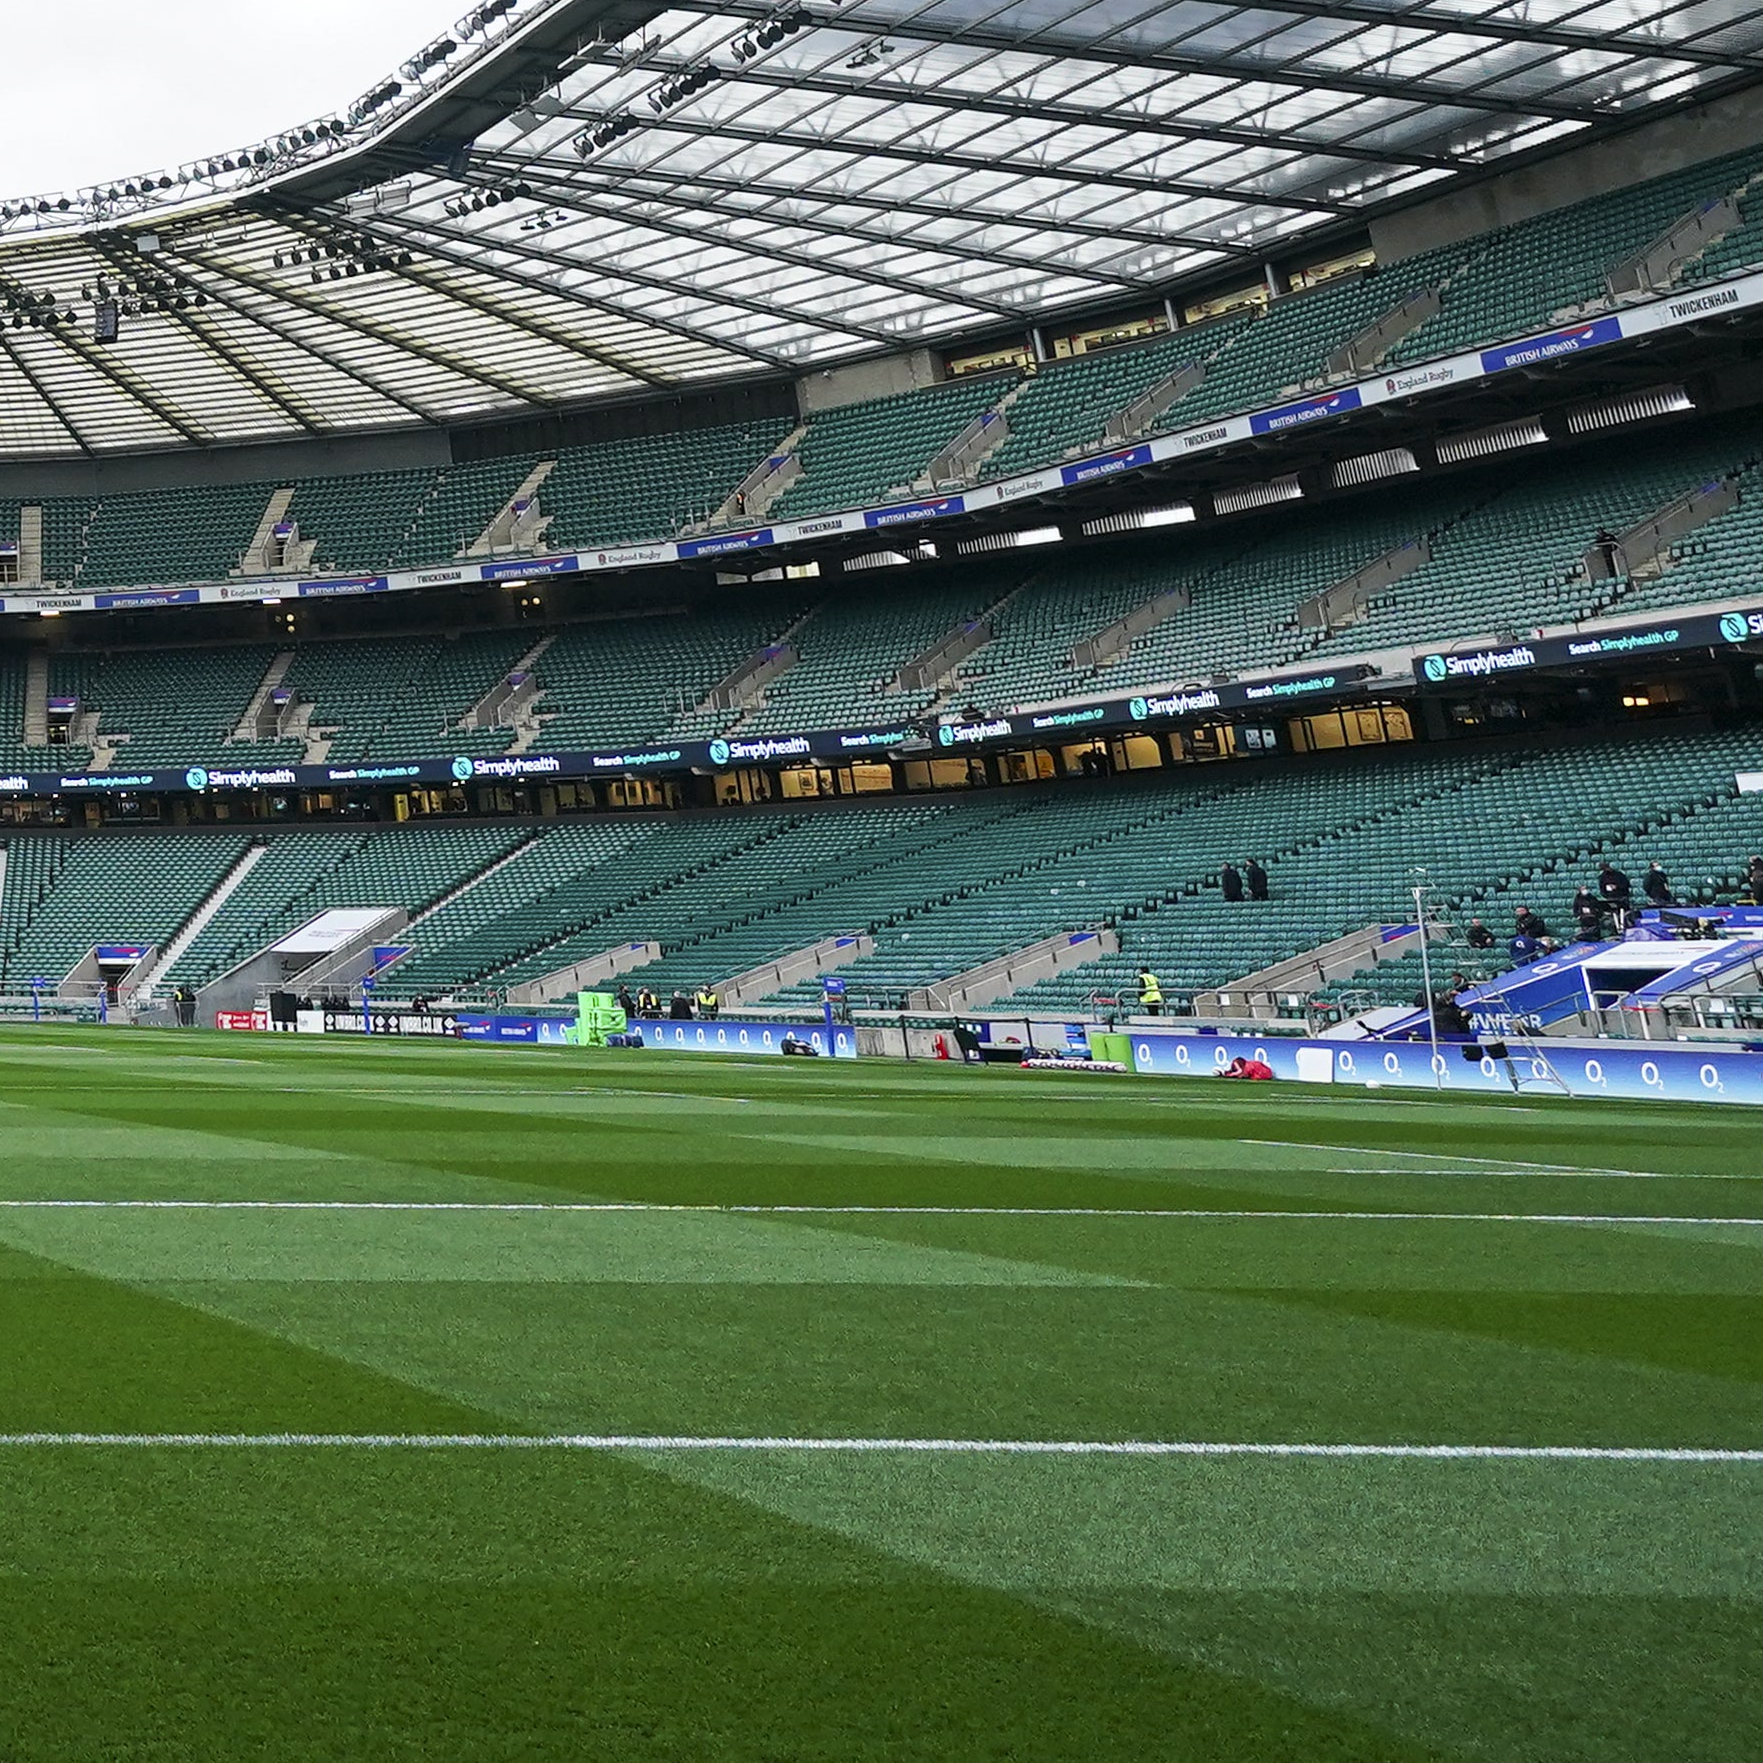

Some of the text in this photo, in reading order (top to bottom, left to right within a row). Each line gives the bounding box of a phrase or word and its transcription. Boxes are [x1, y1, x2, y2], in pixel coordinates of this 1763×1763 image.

[1669, 290, 1739, 318] TWICKENHAM
[1505, 340, 1579, 367] BRITISH AIRWAYS
[1397, 368, 1454, 391] England Rugby
[1269, 407, 1327, 429] BRITISH AIRWAYS
[1184, 427, 1227, 448] TWICKENHAM
[797, 520, 842, 534] TWICKENHAM
[878, 508, 935, 525] BRITISH AIRWAYS
[608, 550, 661, 564] England Rugby
[697, 539, 749, 554] BRITISH AIRWAYS
[417, 571, 462, 583] TWICKENHAM
[230, 587, 281, 598] England Rugby
[1569, 630, 1679, 655] Search Simplyhealth GP
[1446, 648, 1535, 675] Simplyhealth
[1246, 677, 1335, 698] Search Simplyhealth GP
[1147, 692, 1219, 715] Simplyhealth
[841, 735, 869, 746] Search
[953, 720, 1012, 742] Simplyhealth
[730, 737, 811, 759] Simplyhealth
[473, 757, 559, 776] Simplyhealth
[209, 770, 295, 788] Simplyhealth
[1138, 1044, 1153, 1067] O2
[1175, 1044, 1191, 1068] O2
[1339, 1050, 1357, 1076] O2
[1384, 1052, 1403, 1077] O2
[1480, 1055, 1501, 1082] O2
[1585, 1059, 1607, 1088] O2
[1641, 1062, 1664, 1090] O2
[1700, 1064, 1724, 1093] O2
